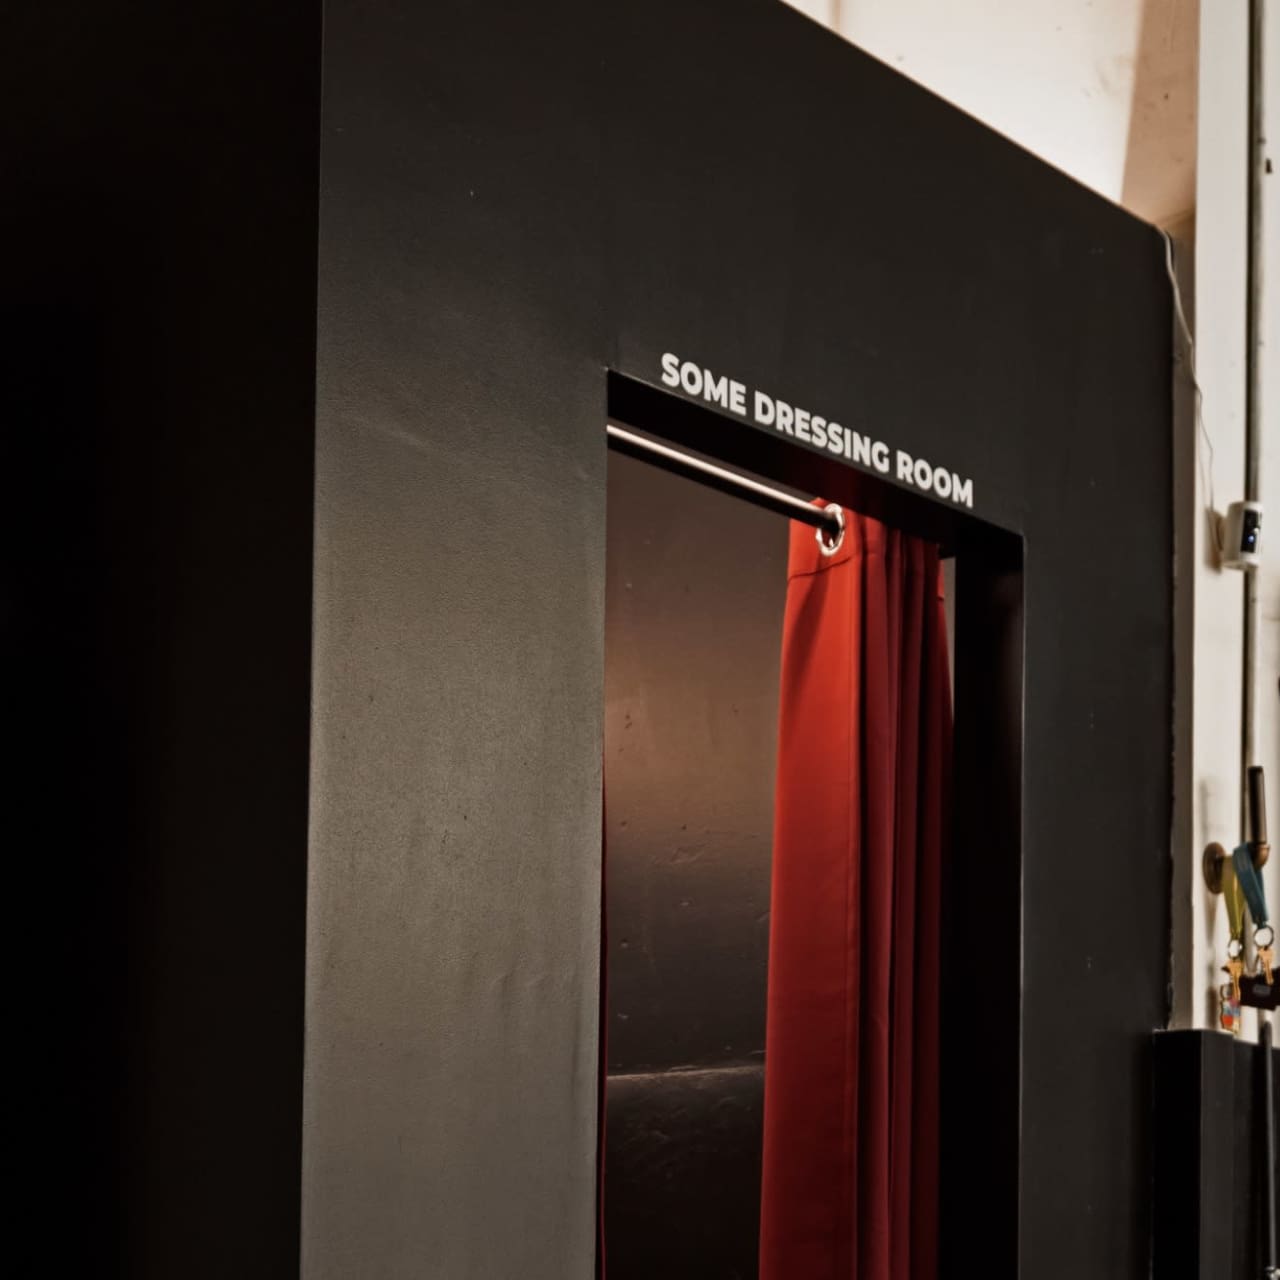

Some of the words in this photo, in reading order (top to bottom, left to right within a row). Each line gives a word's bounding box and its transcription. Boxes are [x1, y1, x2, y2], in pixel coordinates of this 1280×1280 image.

[661, 352, 747, 416] SOME
[754, 390, 890, 473] DRESSING
[896, 450, 974, 508] ROOM
